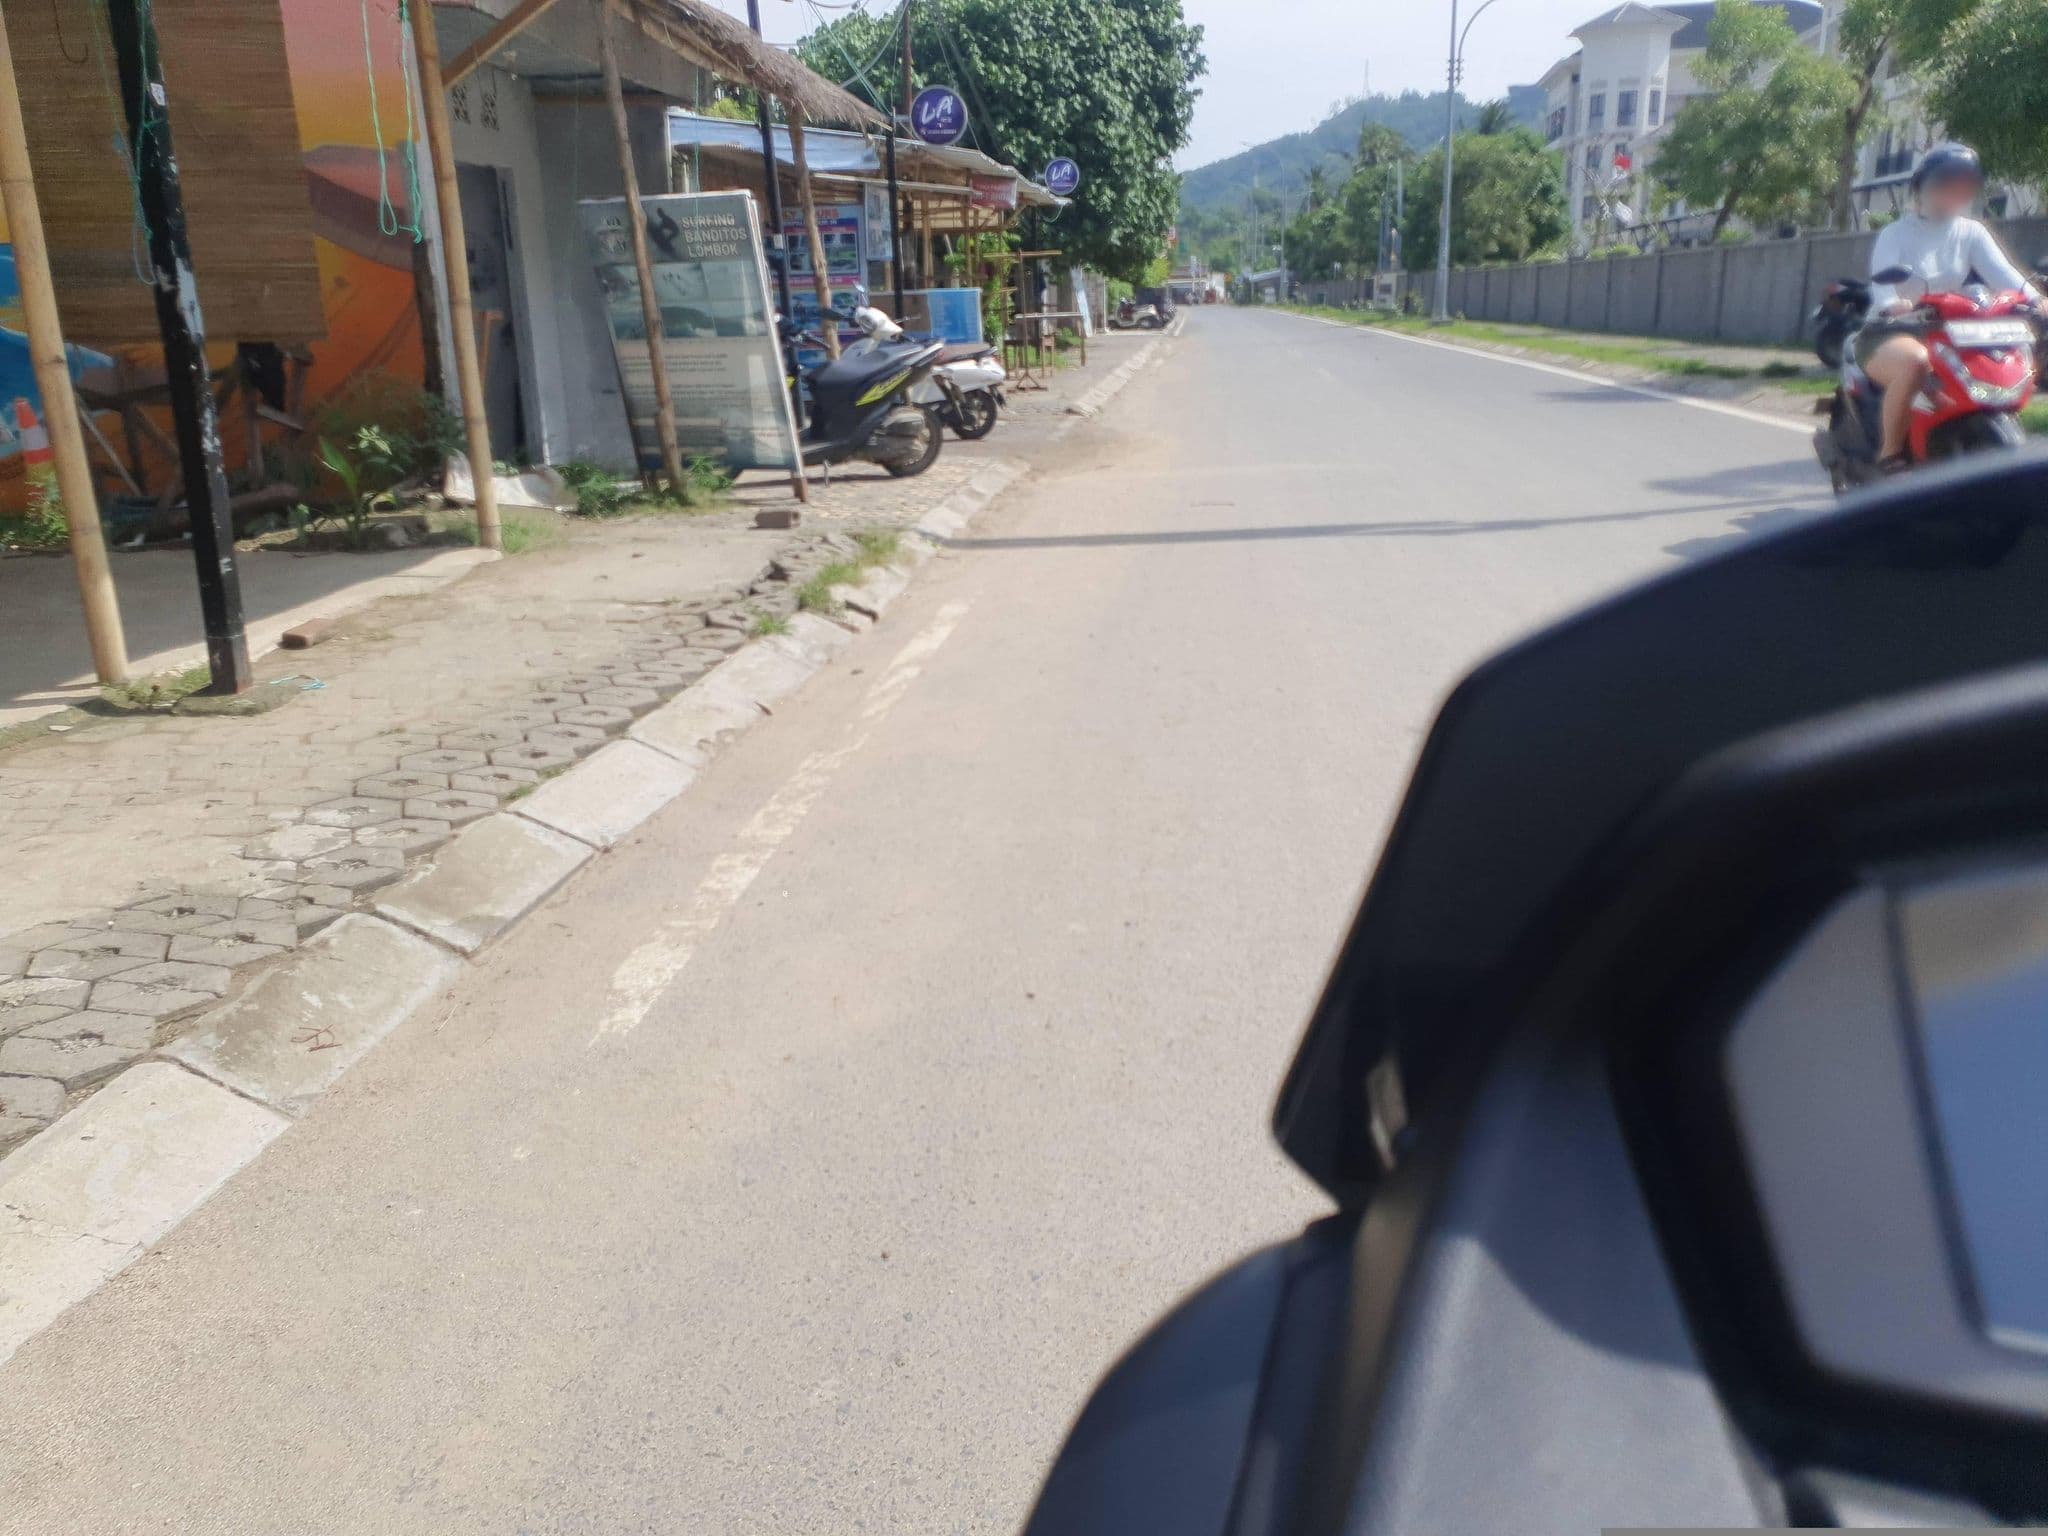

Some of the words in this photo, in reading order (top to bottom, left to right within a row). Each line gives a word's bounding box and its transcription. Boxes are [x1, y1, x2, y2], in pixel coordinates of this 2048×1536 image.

[681, 215, 735, 228] SURFING
[685, 228, 747, 242] BANDITOS
[688, 244, 738, 257] LOMBOK
